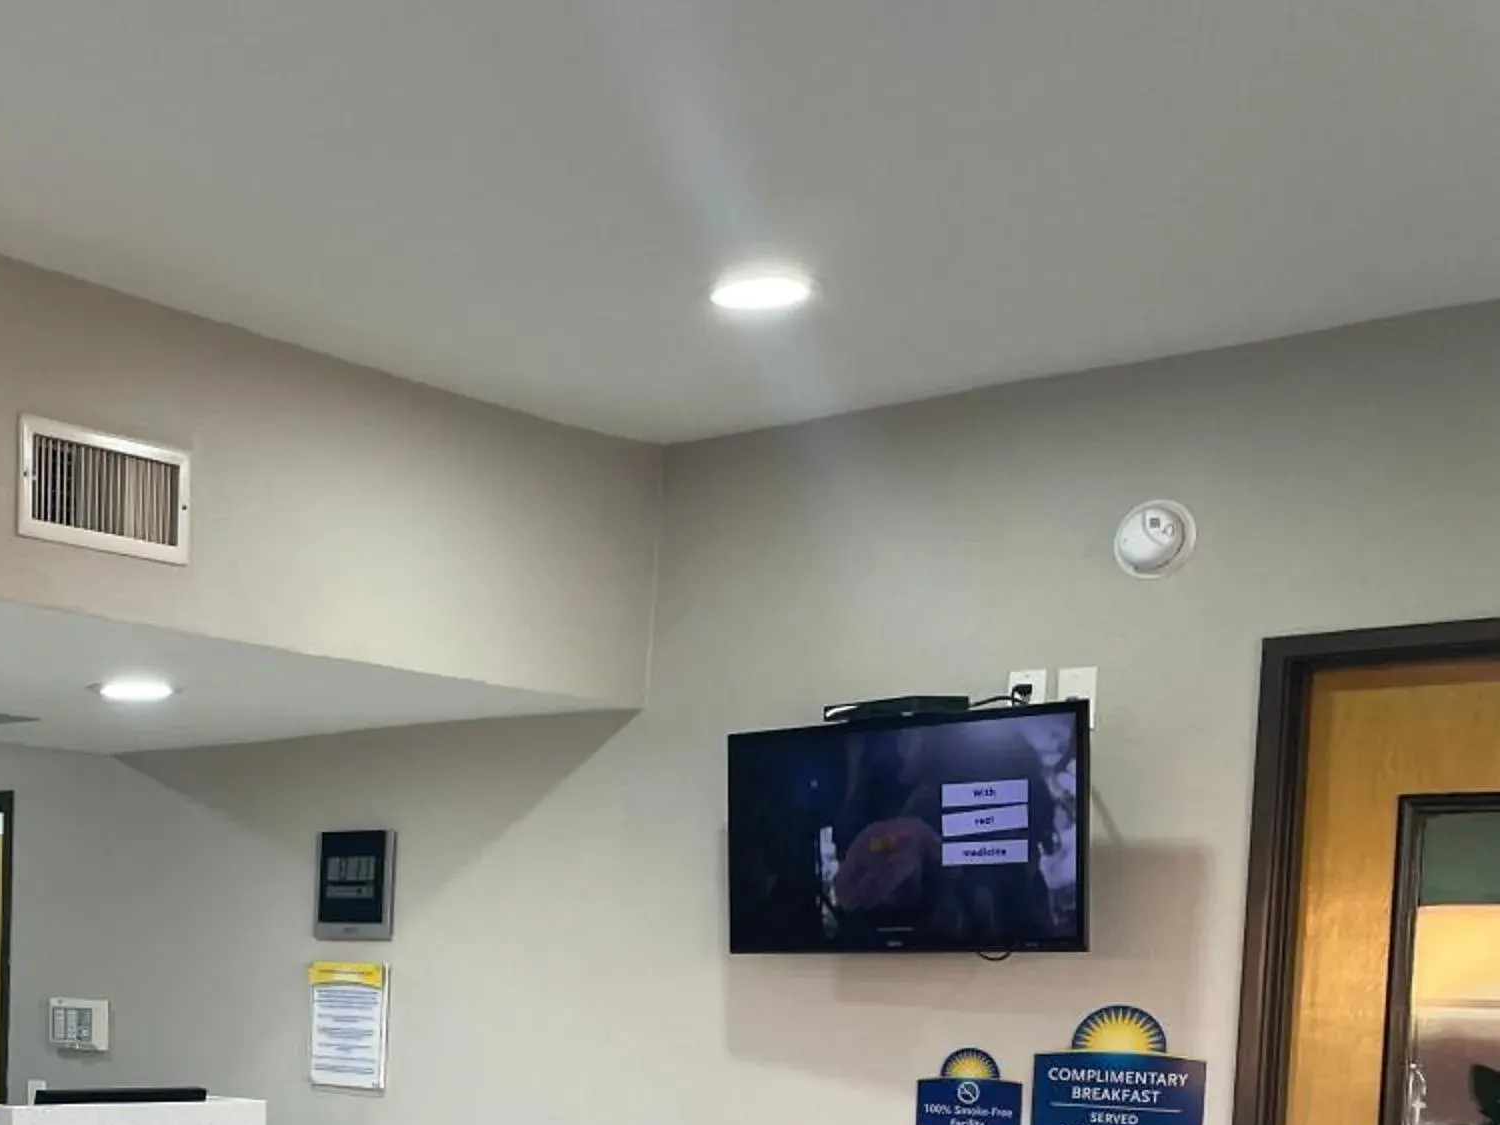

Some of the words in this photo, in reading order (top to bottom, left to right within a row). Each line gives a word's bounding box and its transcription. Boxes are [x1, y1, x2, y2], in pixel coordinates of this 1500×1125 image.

[972, 787, 997, 798] with
[1047, 1067, 1189, 1087] COMPLIMENTARY
[1071, 1085, 1161, 1104] BREAKFAST
[924, 1103, 952, 1115] 100%
[954, 1105, 1013, 1119] Smoke-Free
[1089, 1112, 1139, 1125] SERVED
